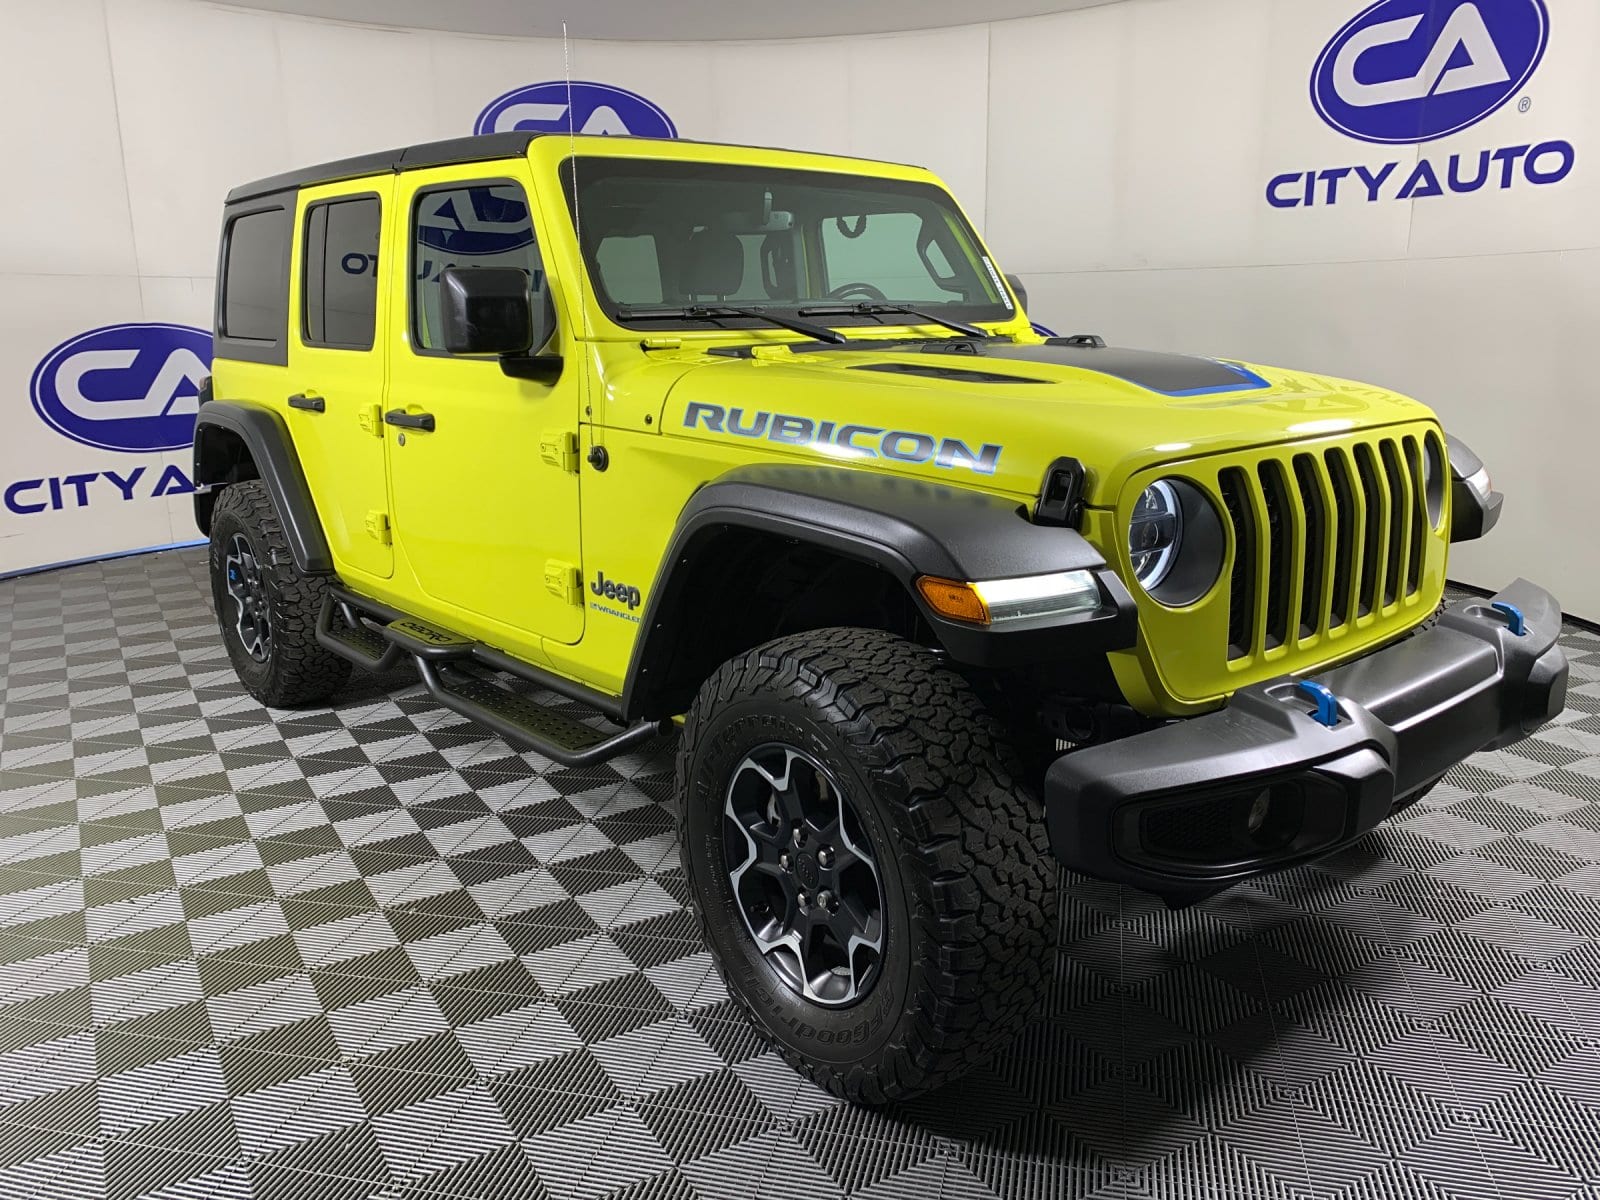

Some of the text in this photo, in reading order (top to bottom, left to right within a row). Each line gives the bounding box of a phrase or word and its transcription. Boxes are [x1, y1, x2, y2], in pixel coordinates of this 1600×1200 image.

[1332, 1, 1512, 107] CA
[54, 347, 212, 421] CA
[683, 400, 1004, 477] RUBICON
[590, 570, 642, 611] Jeep
